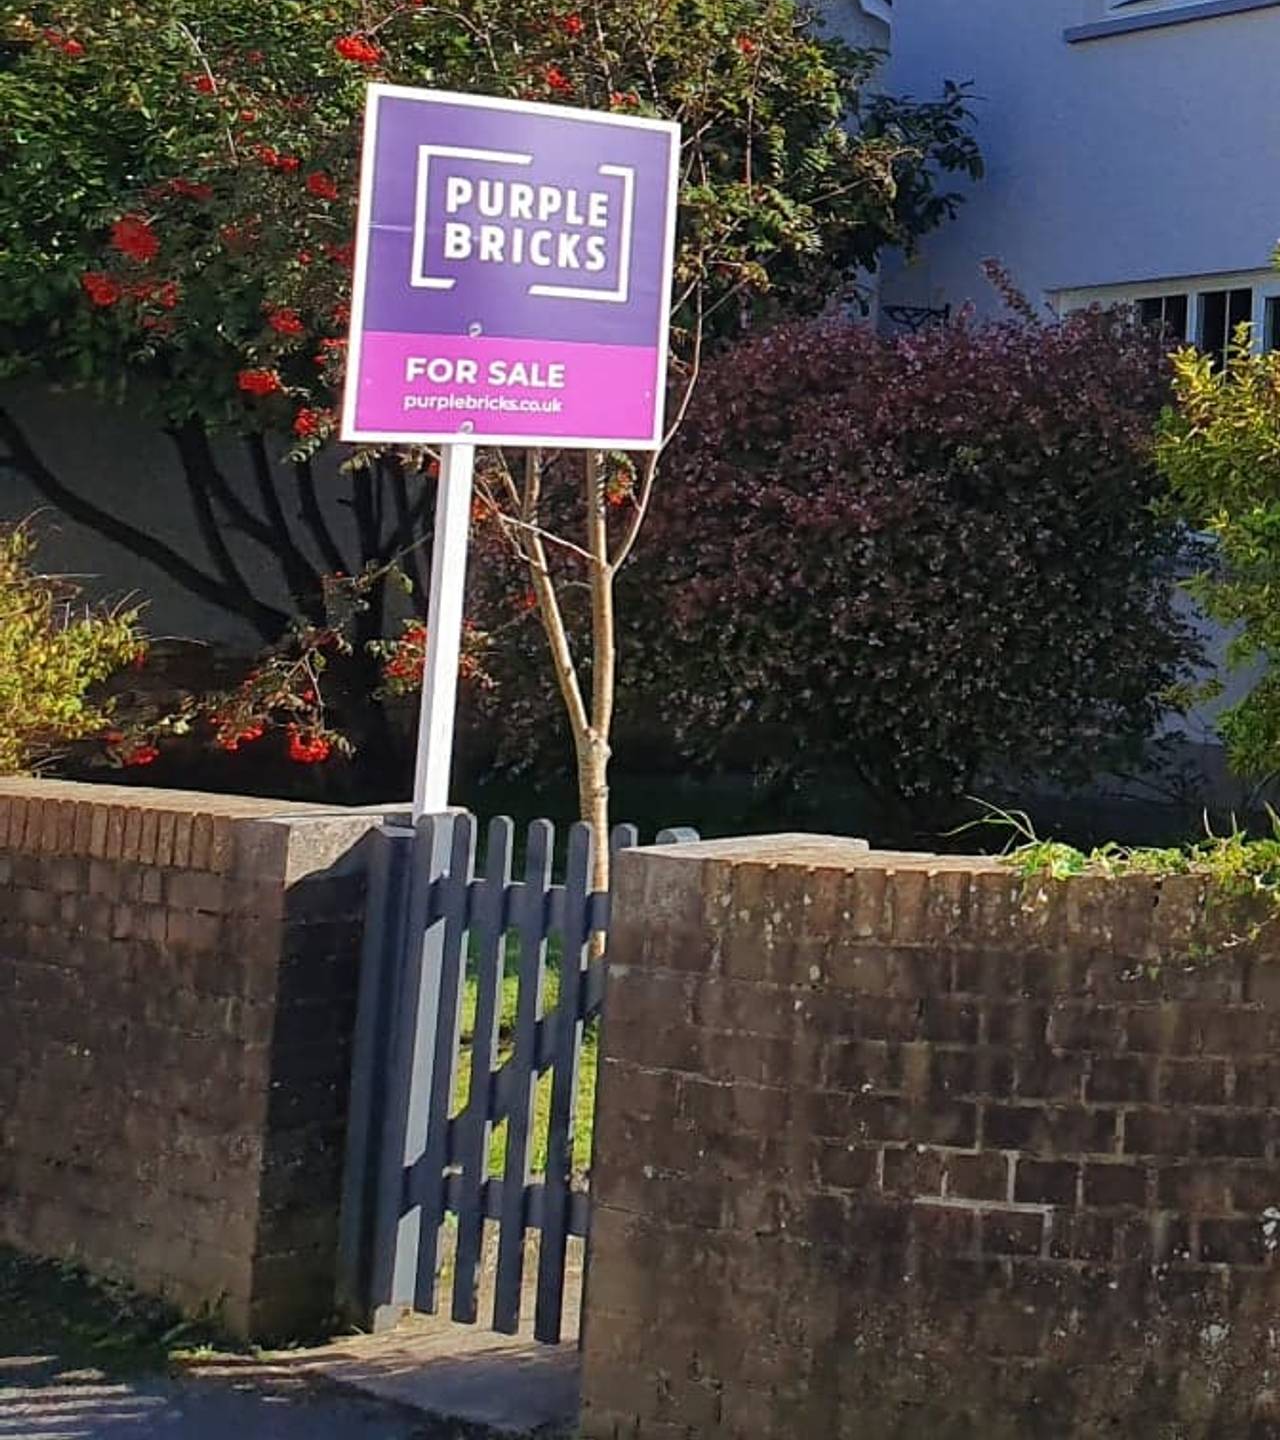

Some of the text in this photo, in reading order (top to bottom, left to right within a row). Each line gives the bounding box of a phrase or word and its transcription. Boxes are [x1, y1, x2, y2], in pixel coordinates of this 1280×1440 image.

[446, 176, 609, 227] PURPLE
[444, 223, 606, 271] BRICKS
[406, 357, 565, 388] FOR SALE
[404, 393, 562, 413] purplebricks.co.uk
